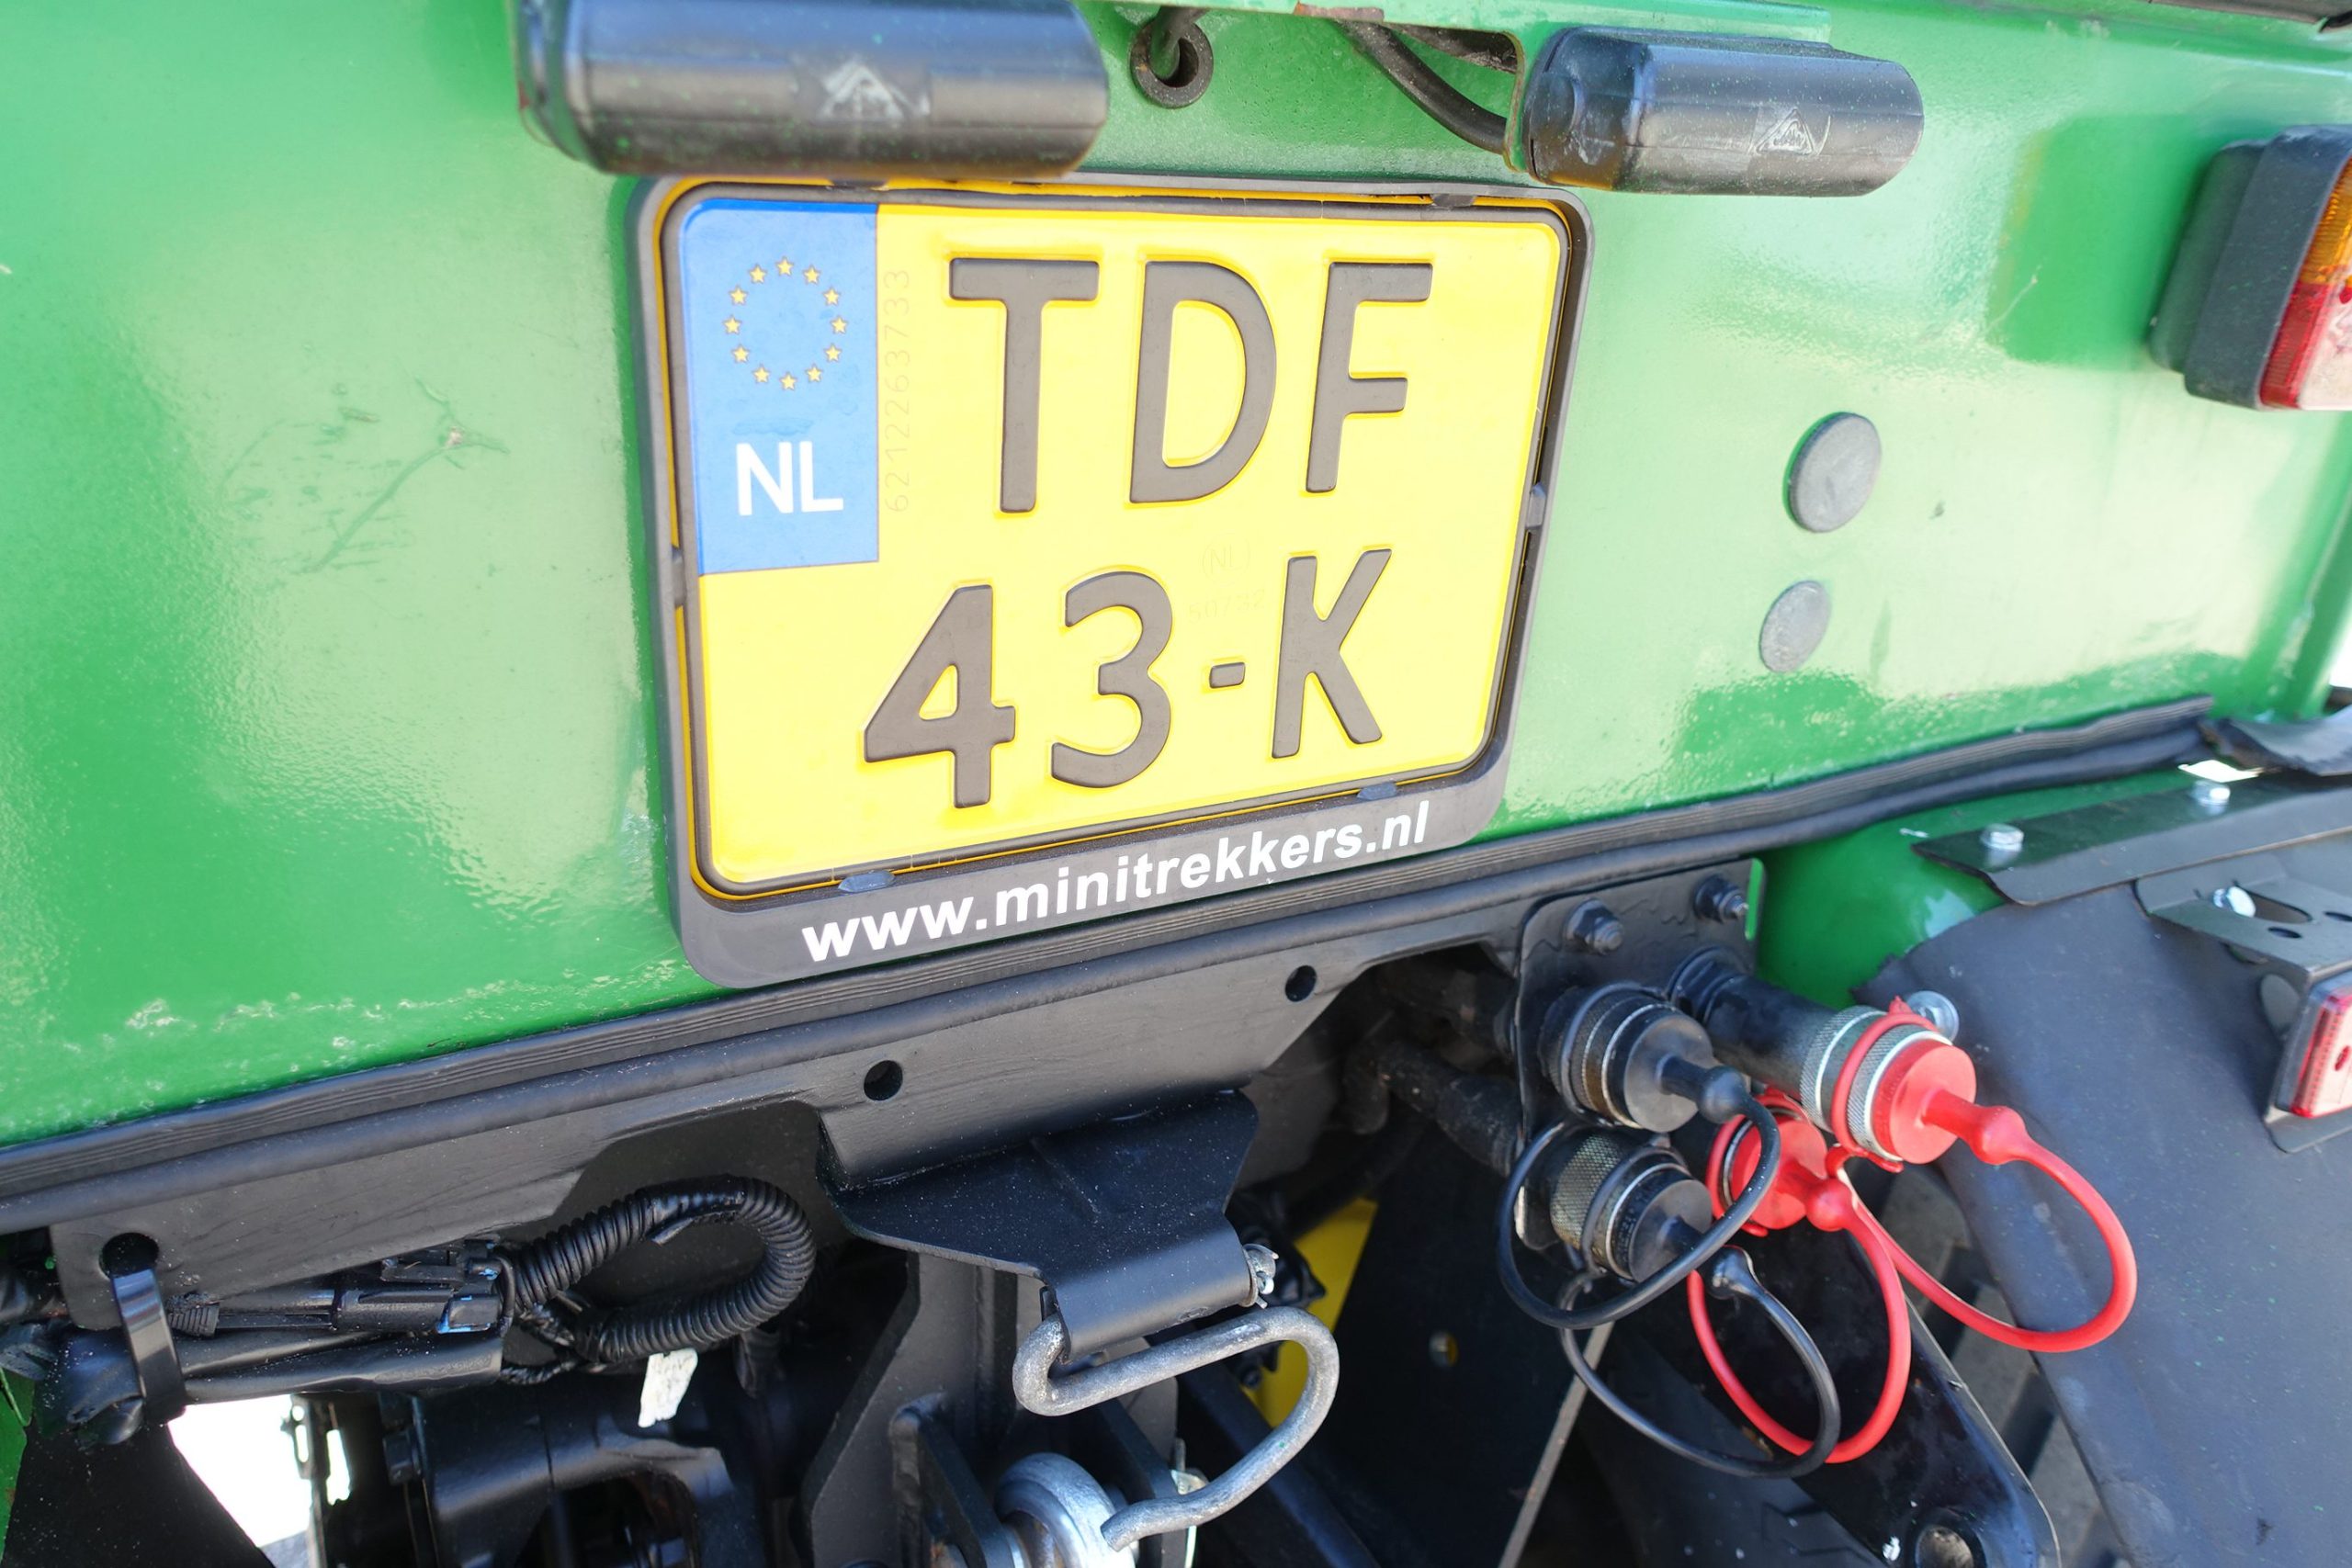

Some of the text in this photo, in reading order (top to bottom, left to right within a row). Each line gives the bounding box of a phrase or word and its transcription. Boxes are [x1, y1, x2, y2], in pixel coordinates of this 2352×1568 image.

[736, 441, 844, 516] NL
[883, 269, 910, 513] 6212263733
[949, 258, 1433, 513] TDF
[863, 548, 1392, 808] 43-K
[801, 800, 1430, 963] www.minitrekkers.nl
